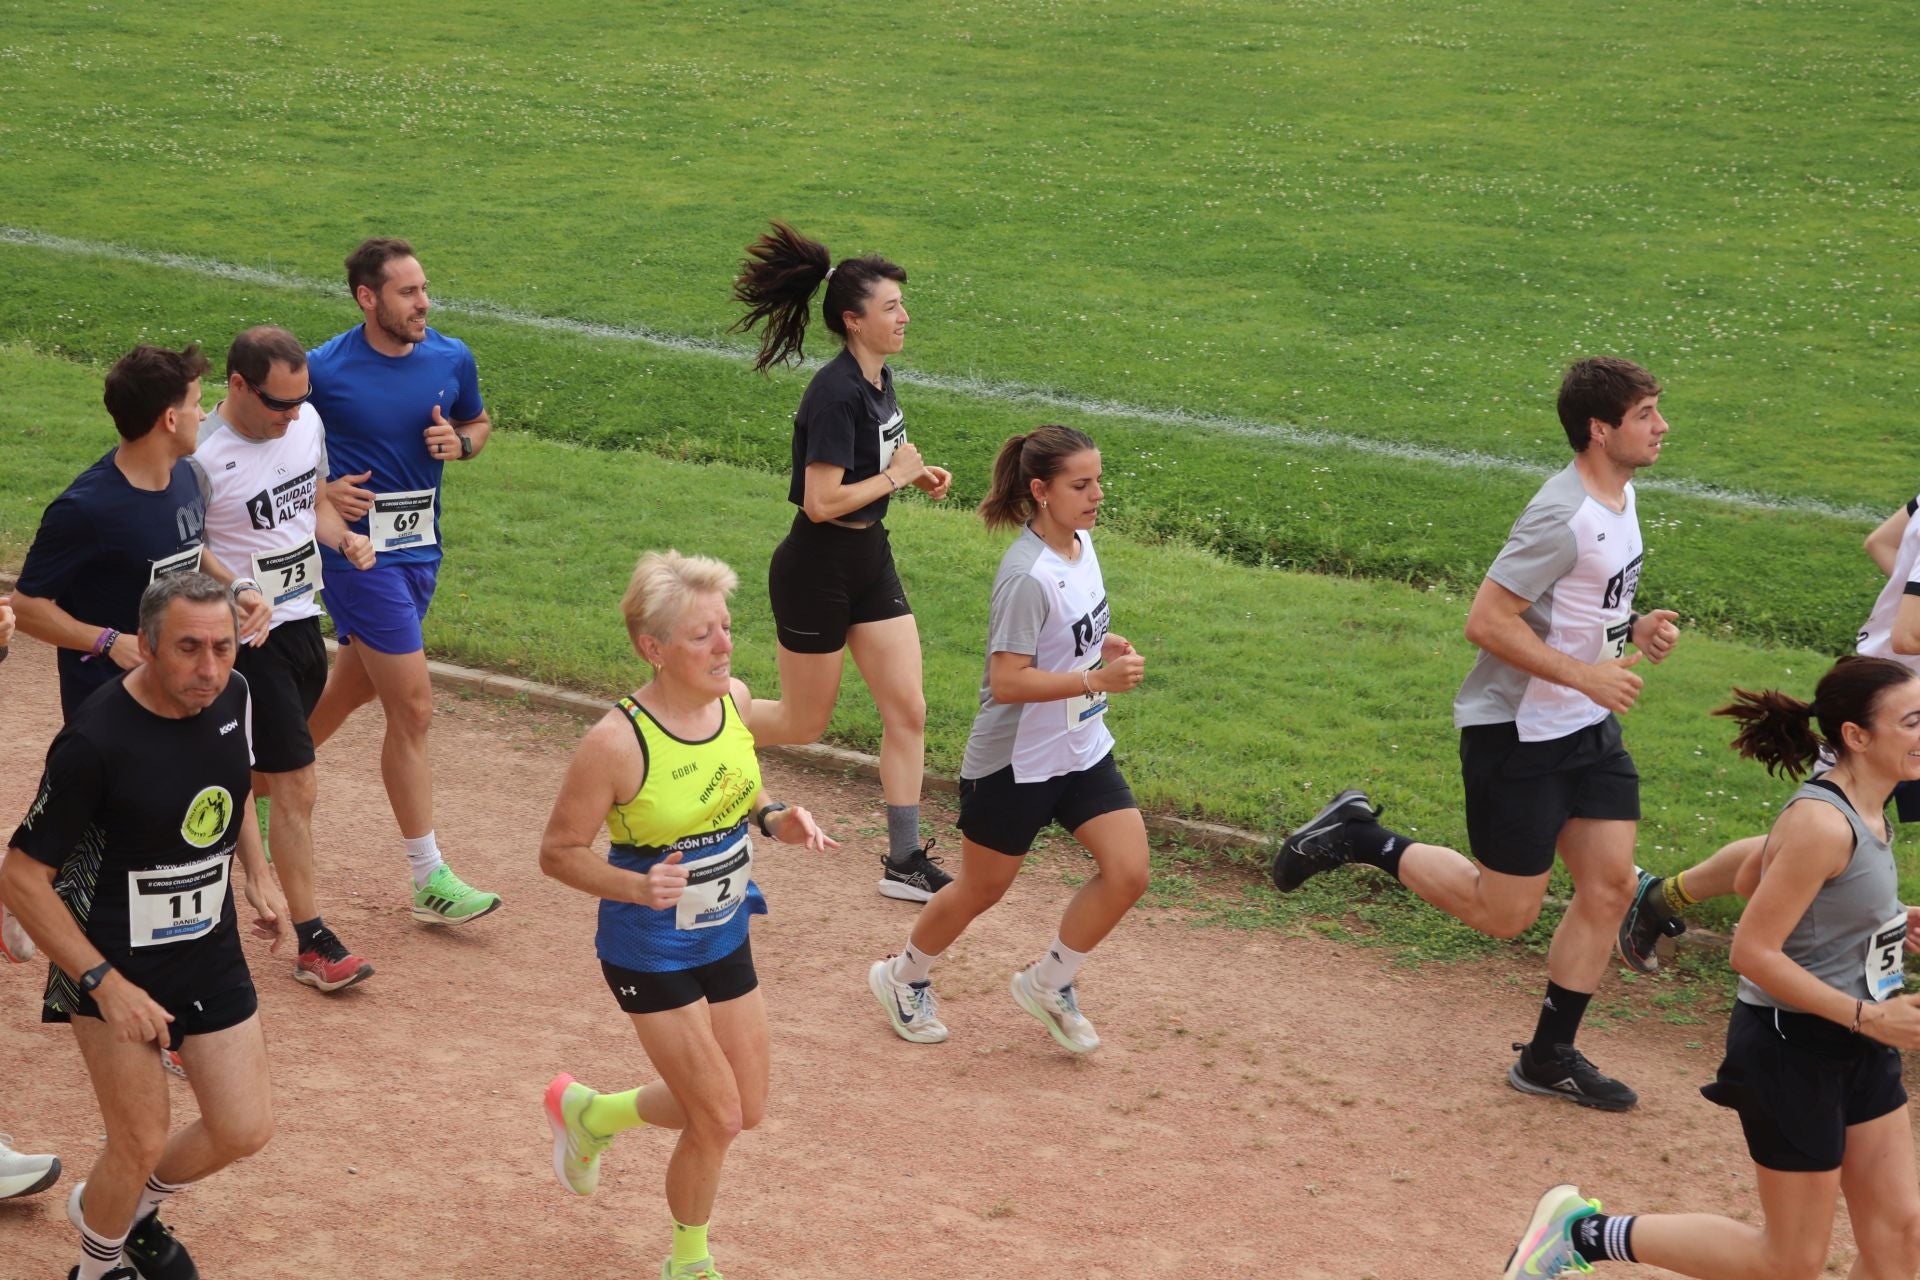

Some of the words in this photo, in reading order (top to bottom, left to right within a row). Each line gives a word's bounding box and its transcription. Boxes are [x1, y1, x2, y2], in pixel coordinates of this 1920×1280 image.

[276, 481, 312, 508] CIUDAD
[393, 512, 420, 532] 69
[280, 562, 306, 589] 73
[672, 762, 698, 780] GOBIK
[700, 763, 728, 804] RINCON
[712, 780, 755, 828] ATLETISMO
[702, 835, 714, 845] DE
[696, 869, 713, 877] CROSS
[713, 863, 729, 873] CIUDAD
[173, 877, 194, 885] CIUDAD
[717, 877, 731, 903] 2
[169, 890, 202, 919] 11
[704, 905, 720, 914] ANA
[173, 917, 200, 926] DANIEL
